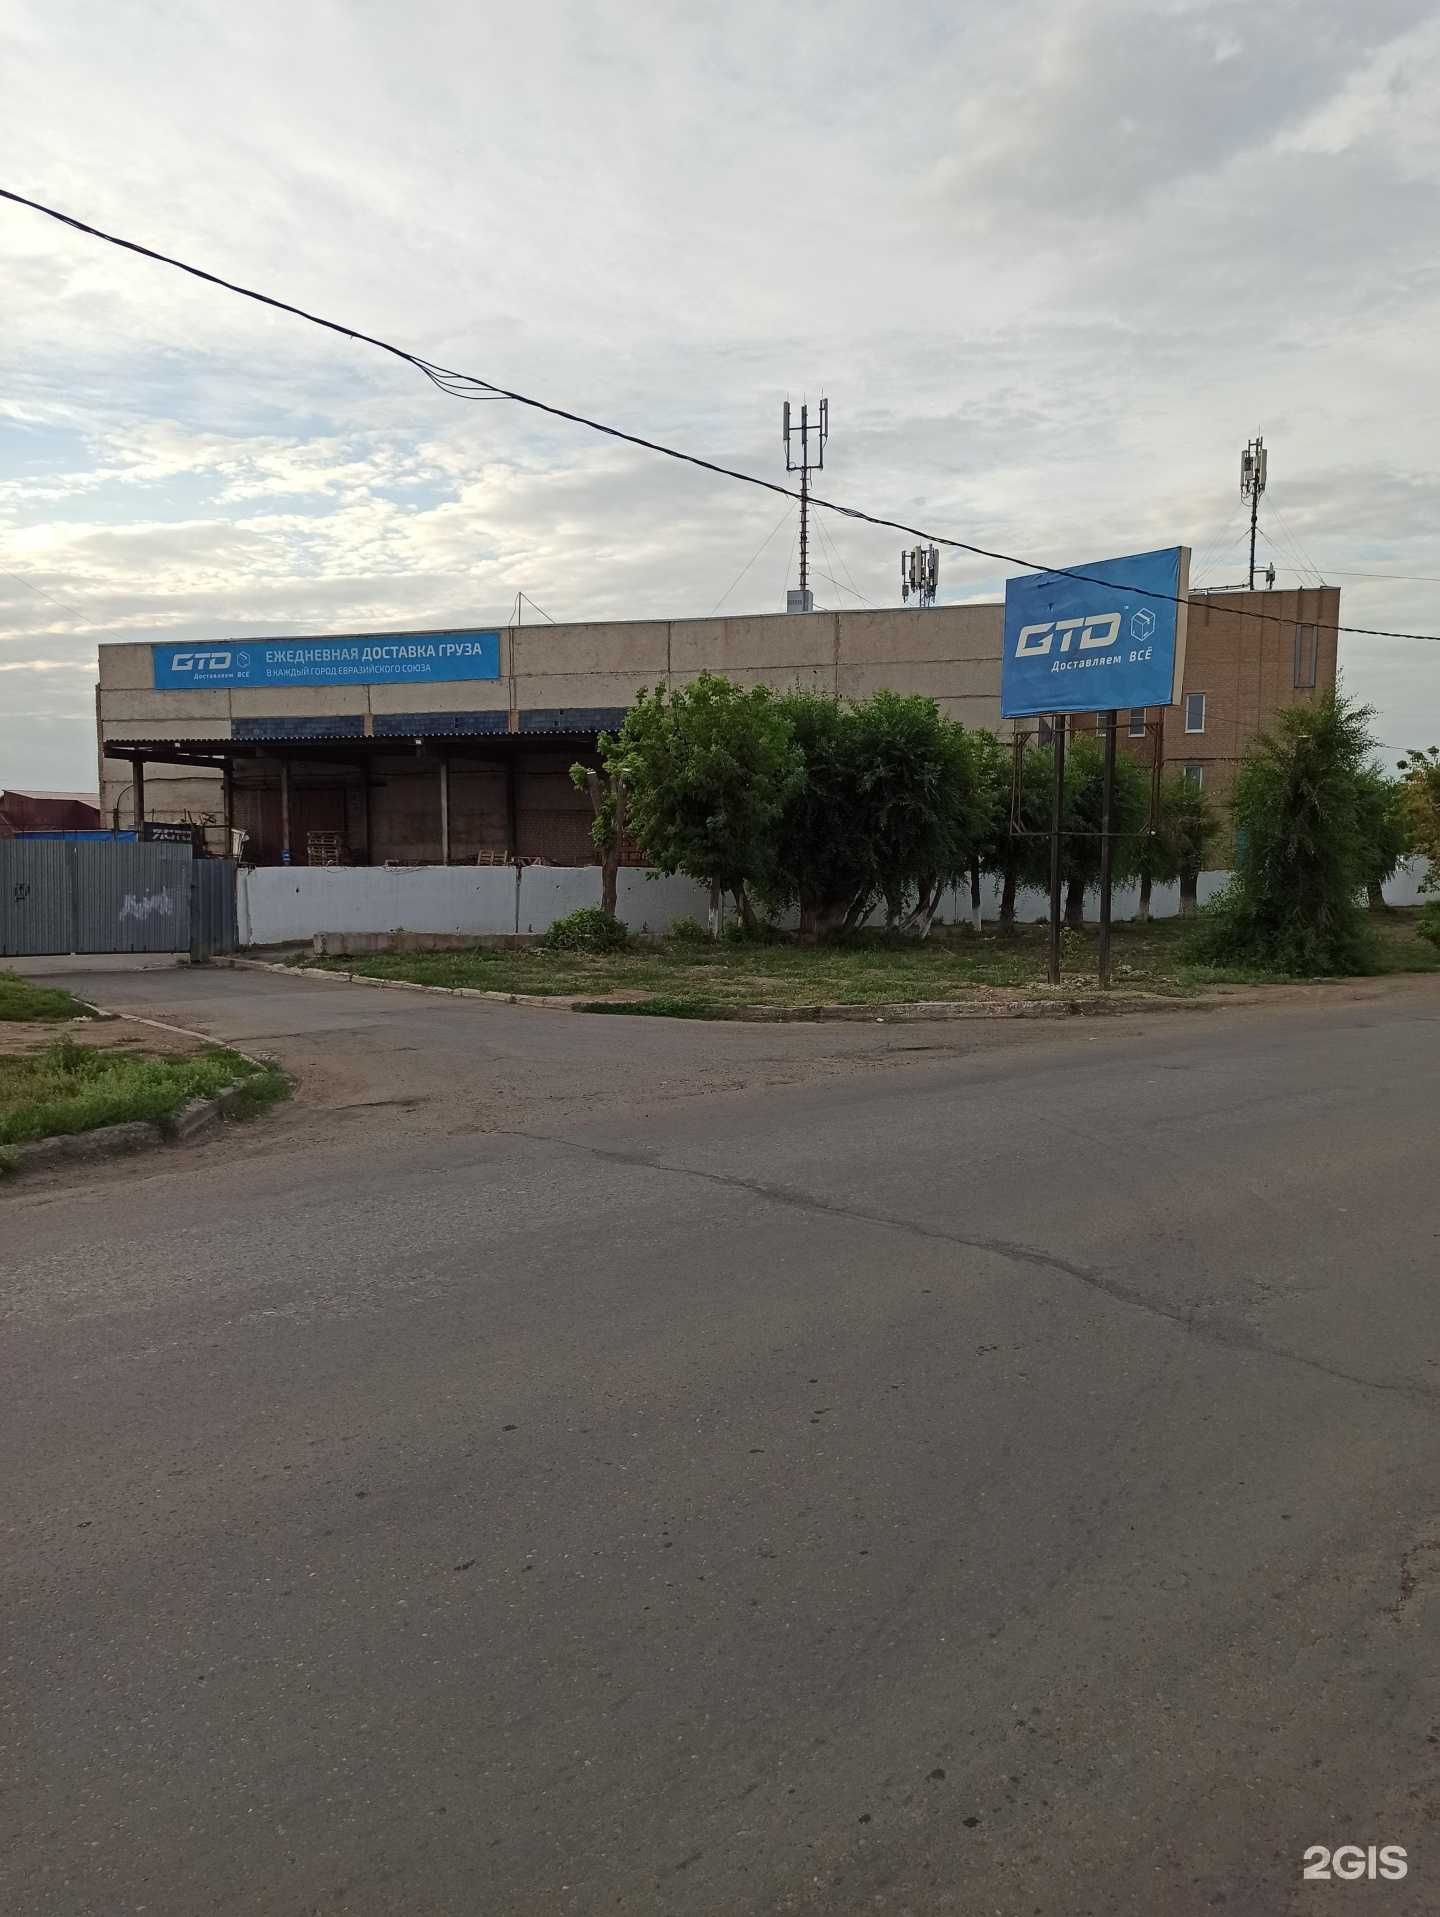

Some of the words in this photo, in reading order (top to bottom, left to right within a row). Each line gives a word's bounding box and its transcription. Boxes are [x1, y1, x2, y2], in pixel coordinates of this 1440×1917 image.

[1015, 612, 1121, 658] GTD
[171, 652, 232, 671] GTD
[265, 647, 360, 664] ЕЖЕДНЕВНАЯ
[361, 644, 436, 663] ДОСТАВКА
[438, 642, 483, 657] ГРУЗА
[273, 666, 310, 677] КАЖДЫЙ
[310, 666, 337, 676] ГОРОД
[338, 664, 401, 675] ЕВРАЗИЙСКОГО
[402, 663, 432, 673] СОЮЗА
[1051, 655, 1122, 673] Доставляем
